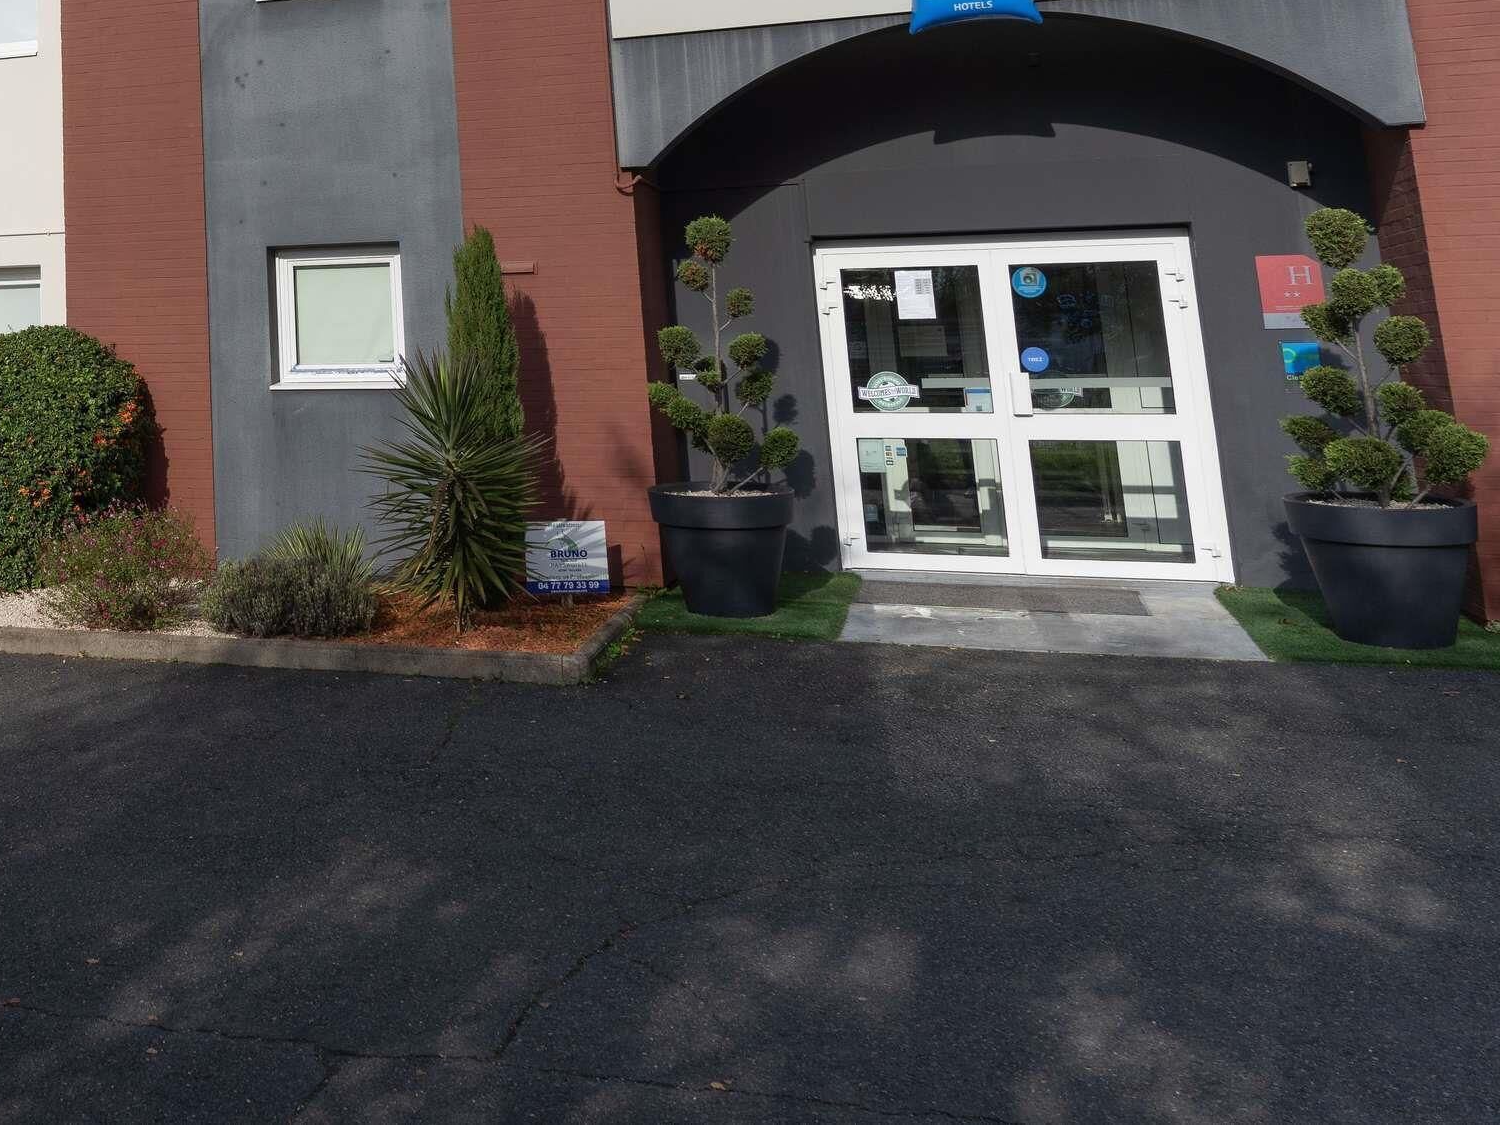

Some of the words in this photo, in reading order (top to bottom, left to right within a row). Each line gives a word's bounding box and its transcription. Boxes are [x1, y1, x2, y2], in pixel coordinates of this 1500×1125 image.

[953, 0, 994, 12] HOTELS
[1287, 265, 1313, 286] H
[550, 549, 587, 558] BRUNO
[538, 582, 549, 590] 04
[551, 581, 561, 589] 77
[576, 581, 587, 589] 33
[588, 581, 599, 589] 99
